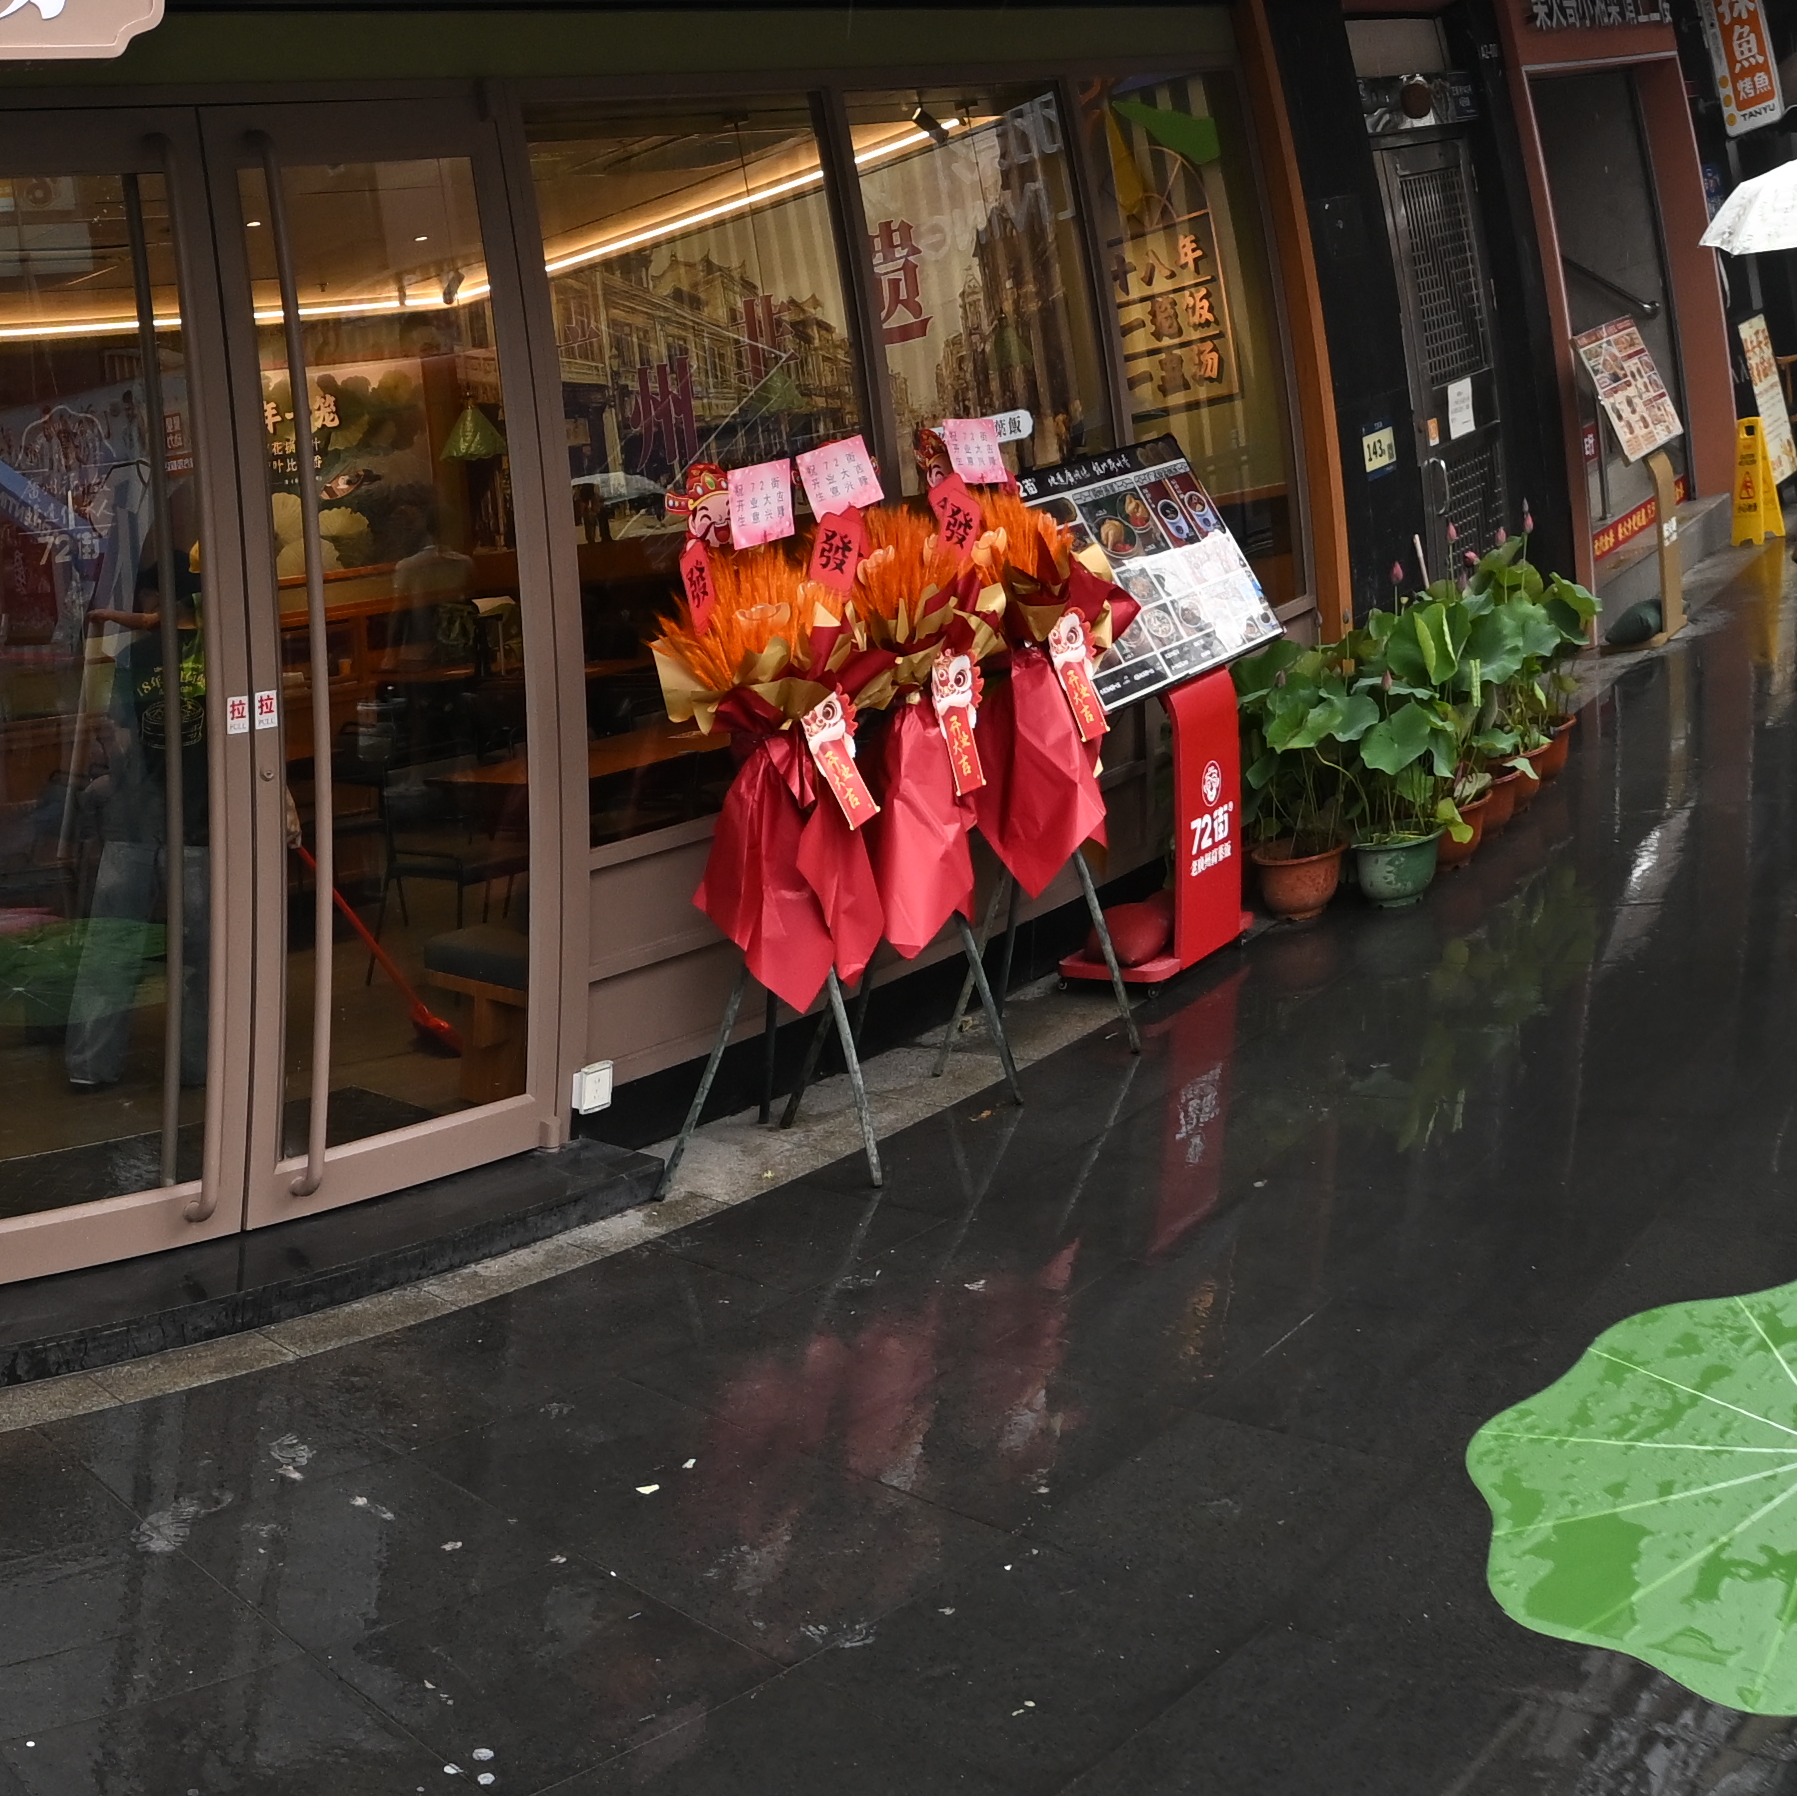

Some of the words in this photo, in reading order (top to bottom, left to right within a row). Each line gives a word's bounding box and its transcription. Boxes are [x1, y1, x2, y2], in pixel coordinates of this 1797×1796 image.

[1736, 71, 1772, 101] 烤魚
[1740, 103, 1776, 122] TANYU
[944, 502, 974, 548] 發
[818, 527, 853, 574] 發
[687, 560, 709, 609] 發
[229, 700, 247, 721] 拉
[258, 695, 275, 717] 拉
